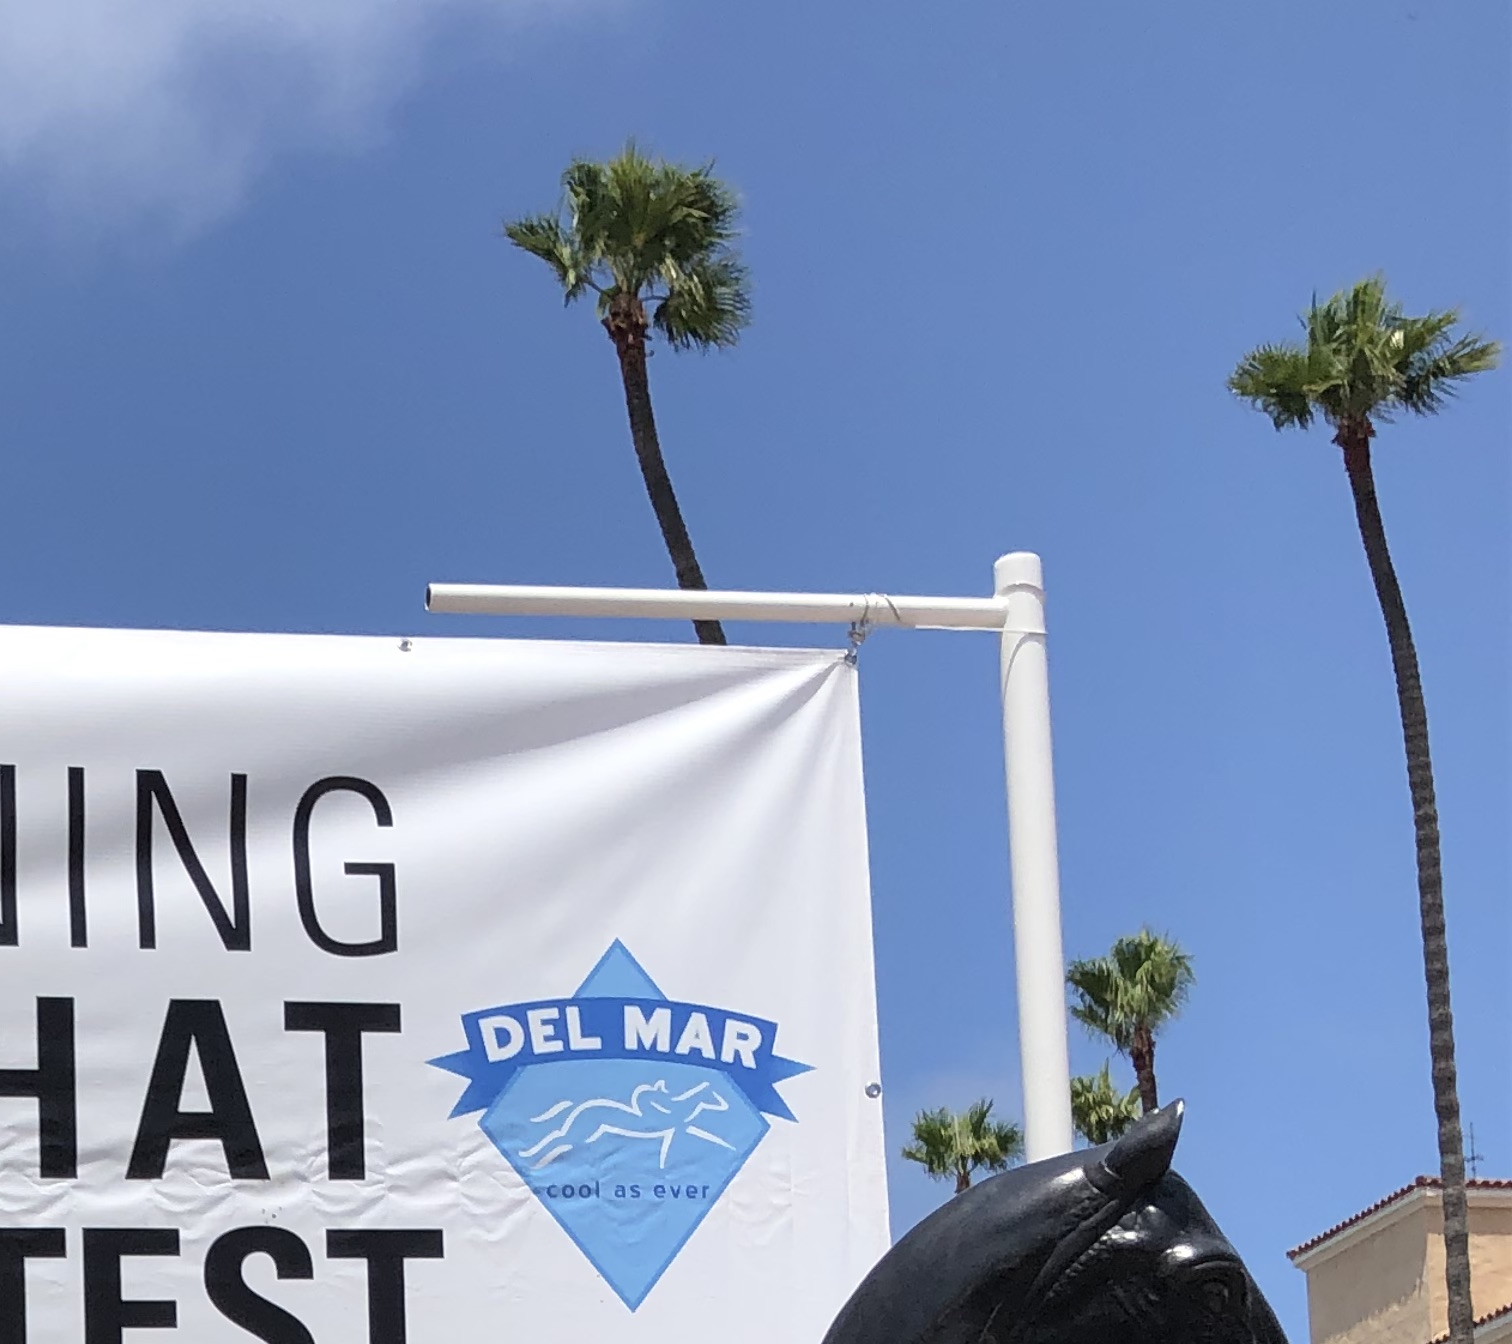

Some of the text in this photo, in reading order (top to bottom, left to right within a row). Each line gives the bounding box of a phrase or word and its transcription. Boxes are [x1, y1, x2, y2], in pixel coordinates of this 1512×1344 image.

[477, 1005, 763, 1069] DEL MAR
[545, 1181, 710, 1199] cool as ever
